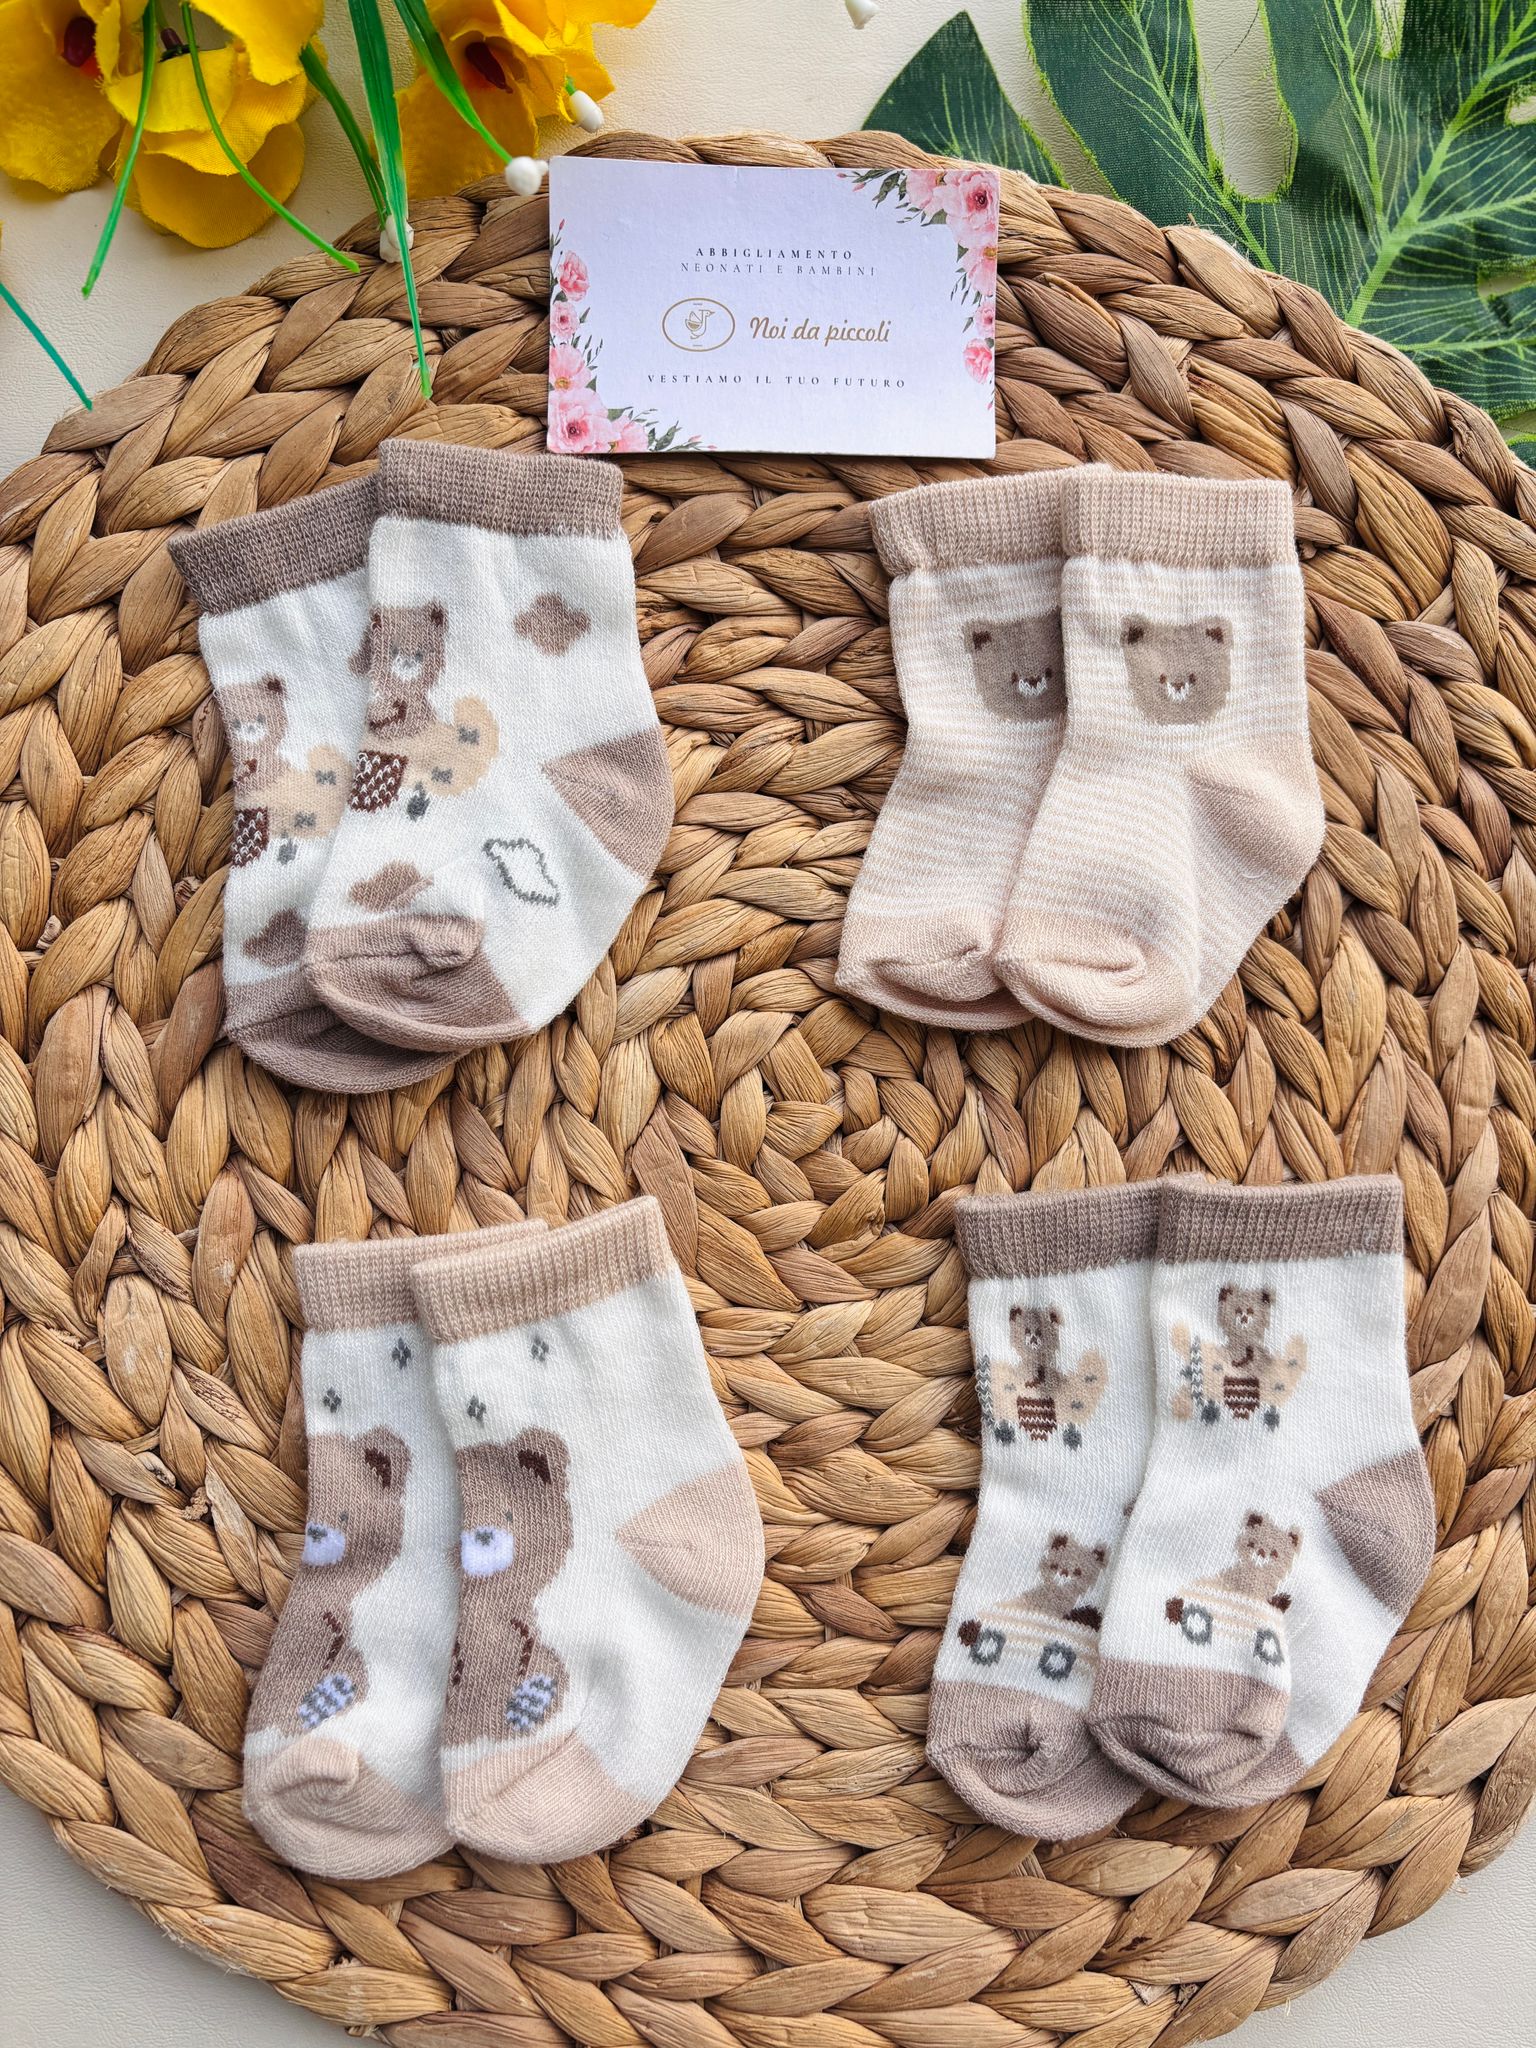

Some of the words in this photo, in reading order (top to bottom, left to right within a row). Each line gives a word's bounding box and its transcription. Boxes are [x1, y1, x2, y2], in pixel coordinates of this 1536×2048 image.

[695, 247, 853, 260] ABBIGLIAMENTO
[680, 262, 763, 274] NEONATI
[776, 265, 784, 275] E
[796, 265, 875, 277] BAMBINI
[749, 316, 790, 340] Noi
[790, 317, 820, 341] da
[823, 319, 892, 348] piccoli
[646, 374, 742, 384] VESTIAMO
[755, 375, 772, 385] IL
[784, 375, 820, 386] TUO
[832, 376, 906, 389] FUTURO
